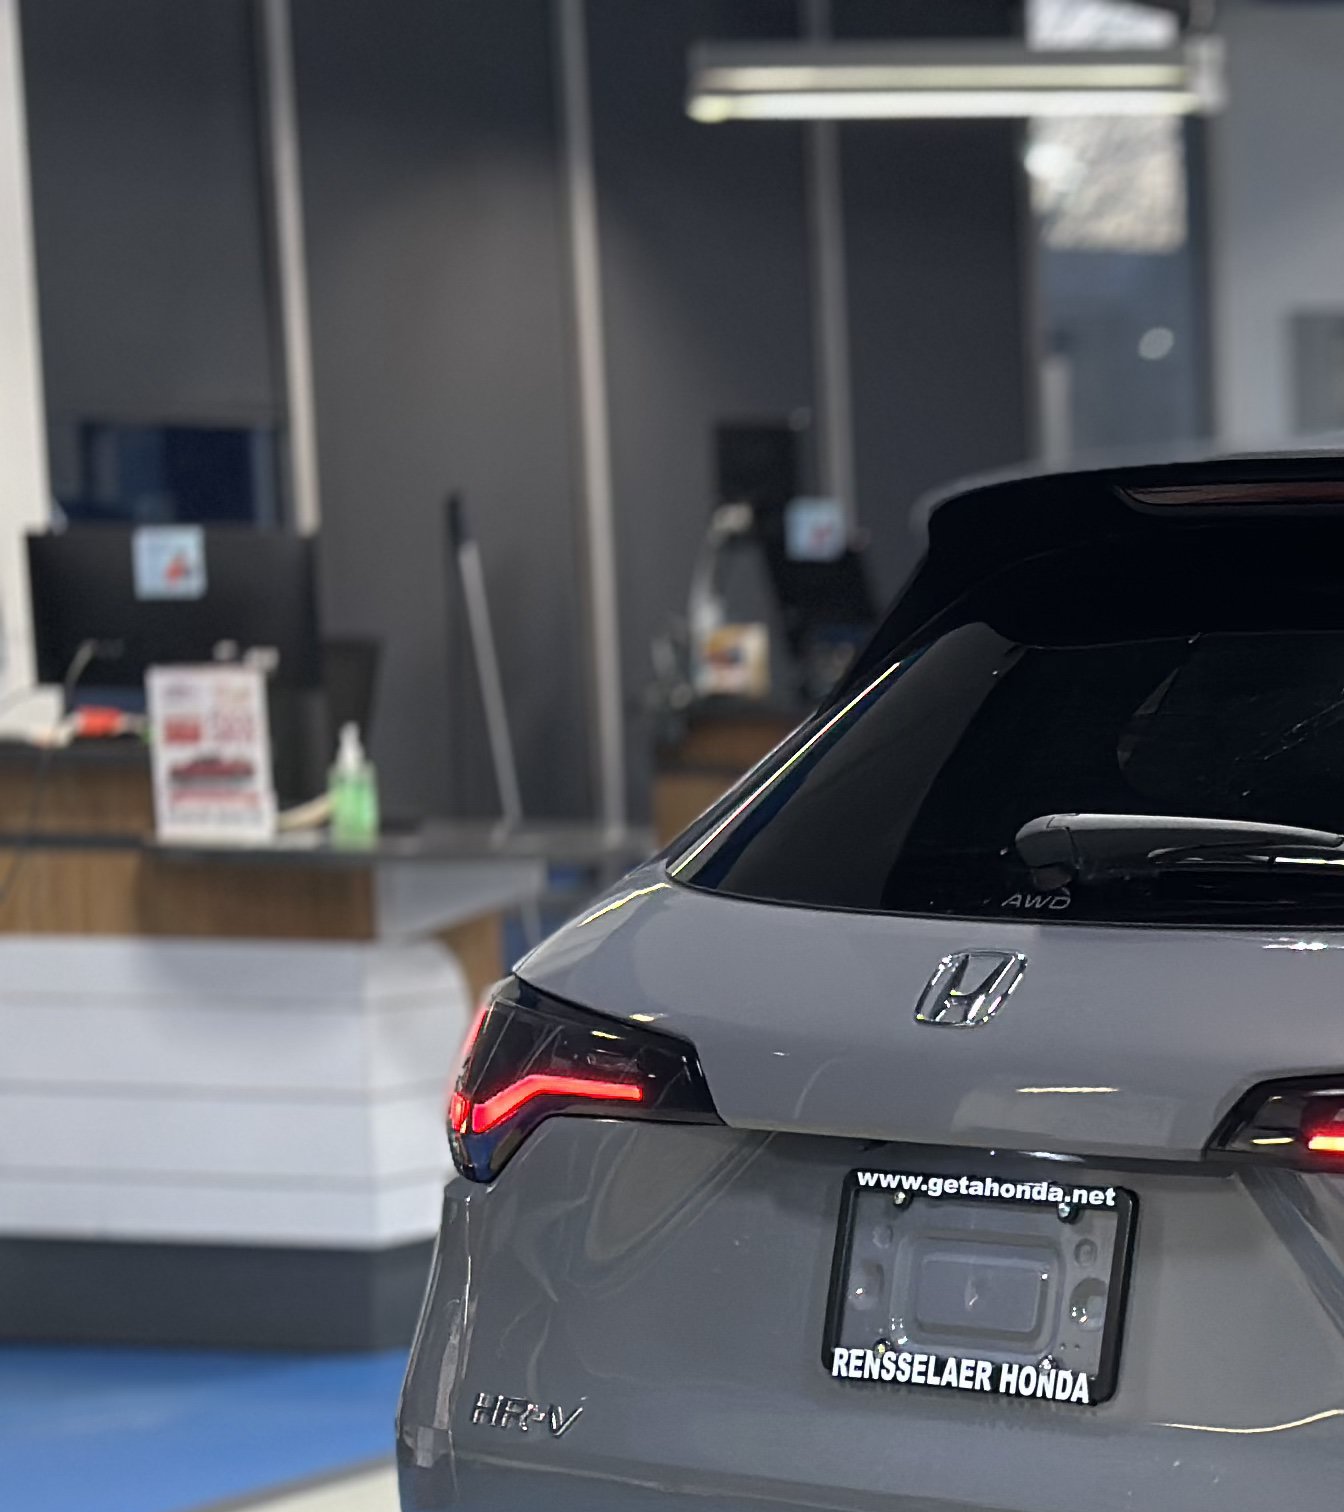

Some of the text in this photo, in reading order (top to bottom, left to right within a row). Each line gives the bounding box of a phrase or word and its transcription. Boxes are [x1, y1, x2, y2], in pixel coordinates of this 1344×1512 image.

[1001, 894, 1071, 909] AWD
[857, 1171, 1117, 1206] www.getahonda.net
[831, 1347, 1090, 1404] RENSSELAER HONDA
[470, 1391, 586, 1438] HR-V
